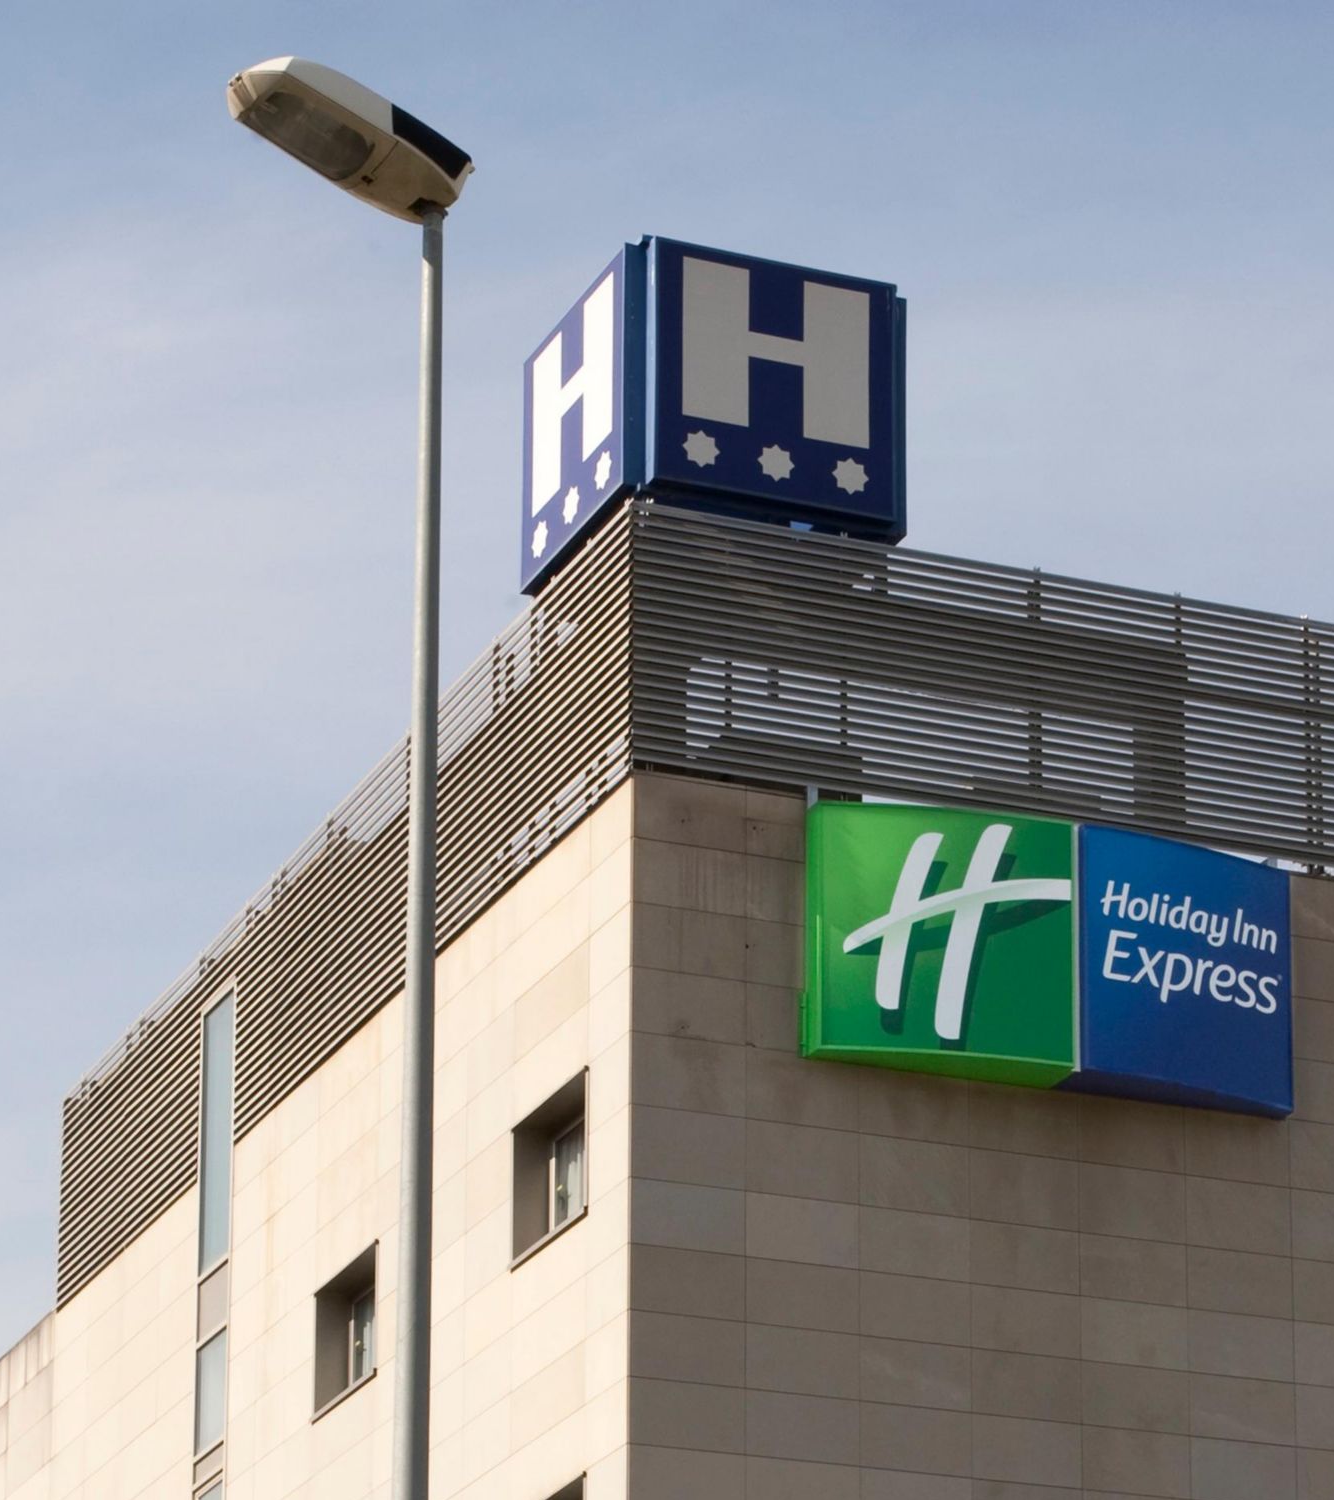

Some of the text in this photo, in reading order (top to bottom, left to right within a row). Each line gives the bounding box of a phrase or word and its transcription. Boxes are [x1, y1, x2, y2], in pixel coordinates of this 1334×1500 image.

[532, 271, 614, 518] H
[682, 256, 870, 449] H
[1100, 880, 1278, 955] Holiday Inn
[1102, 929, 1279, 1014] Express
